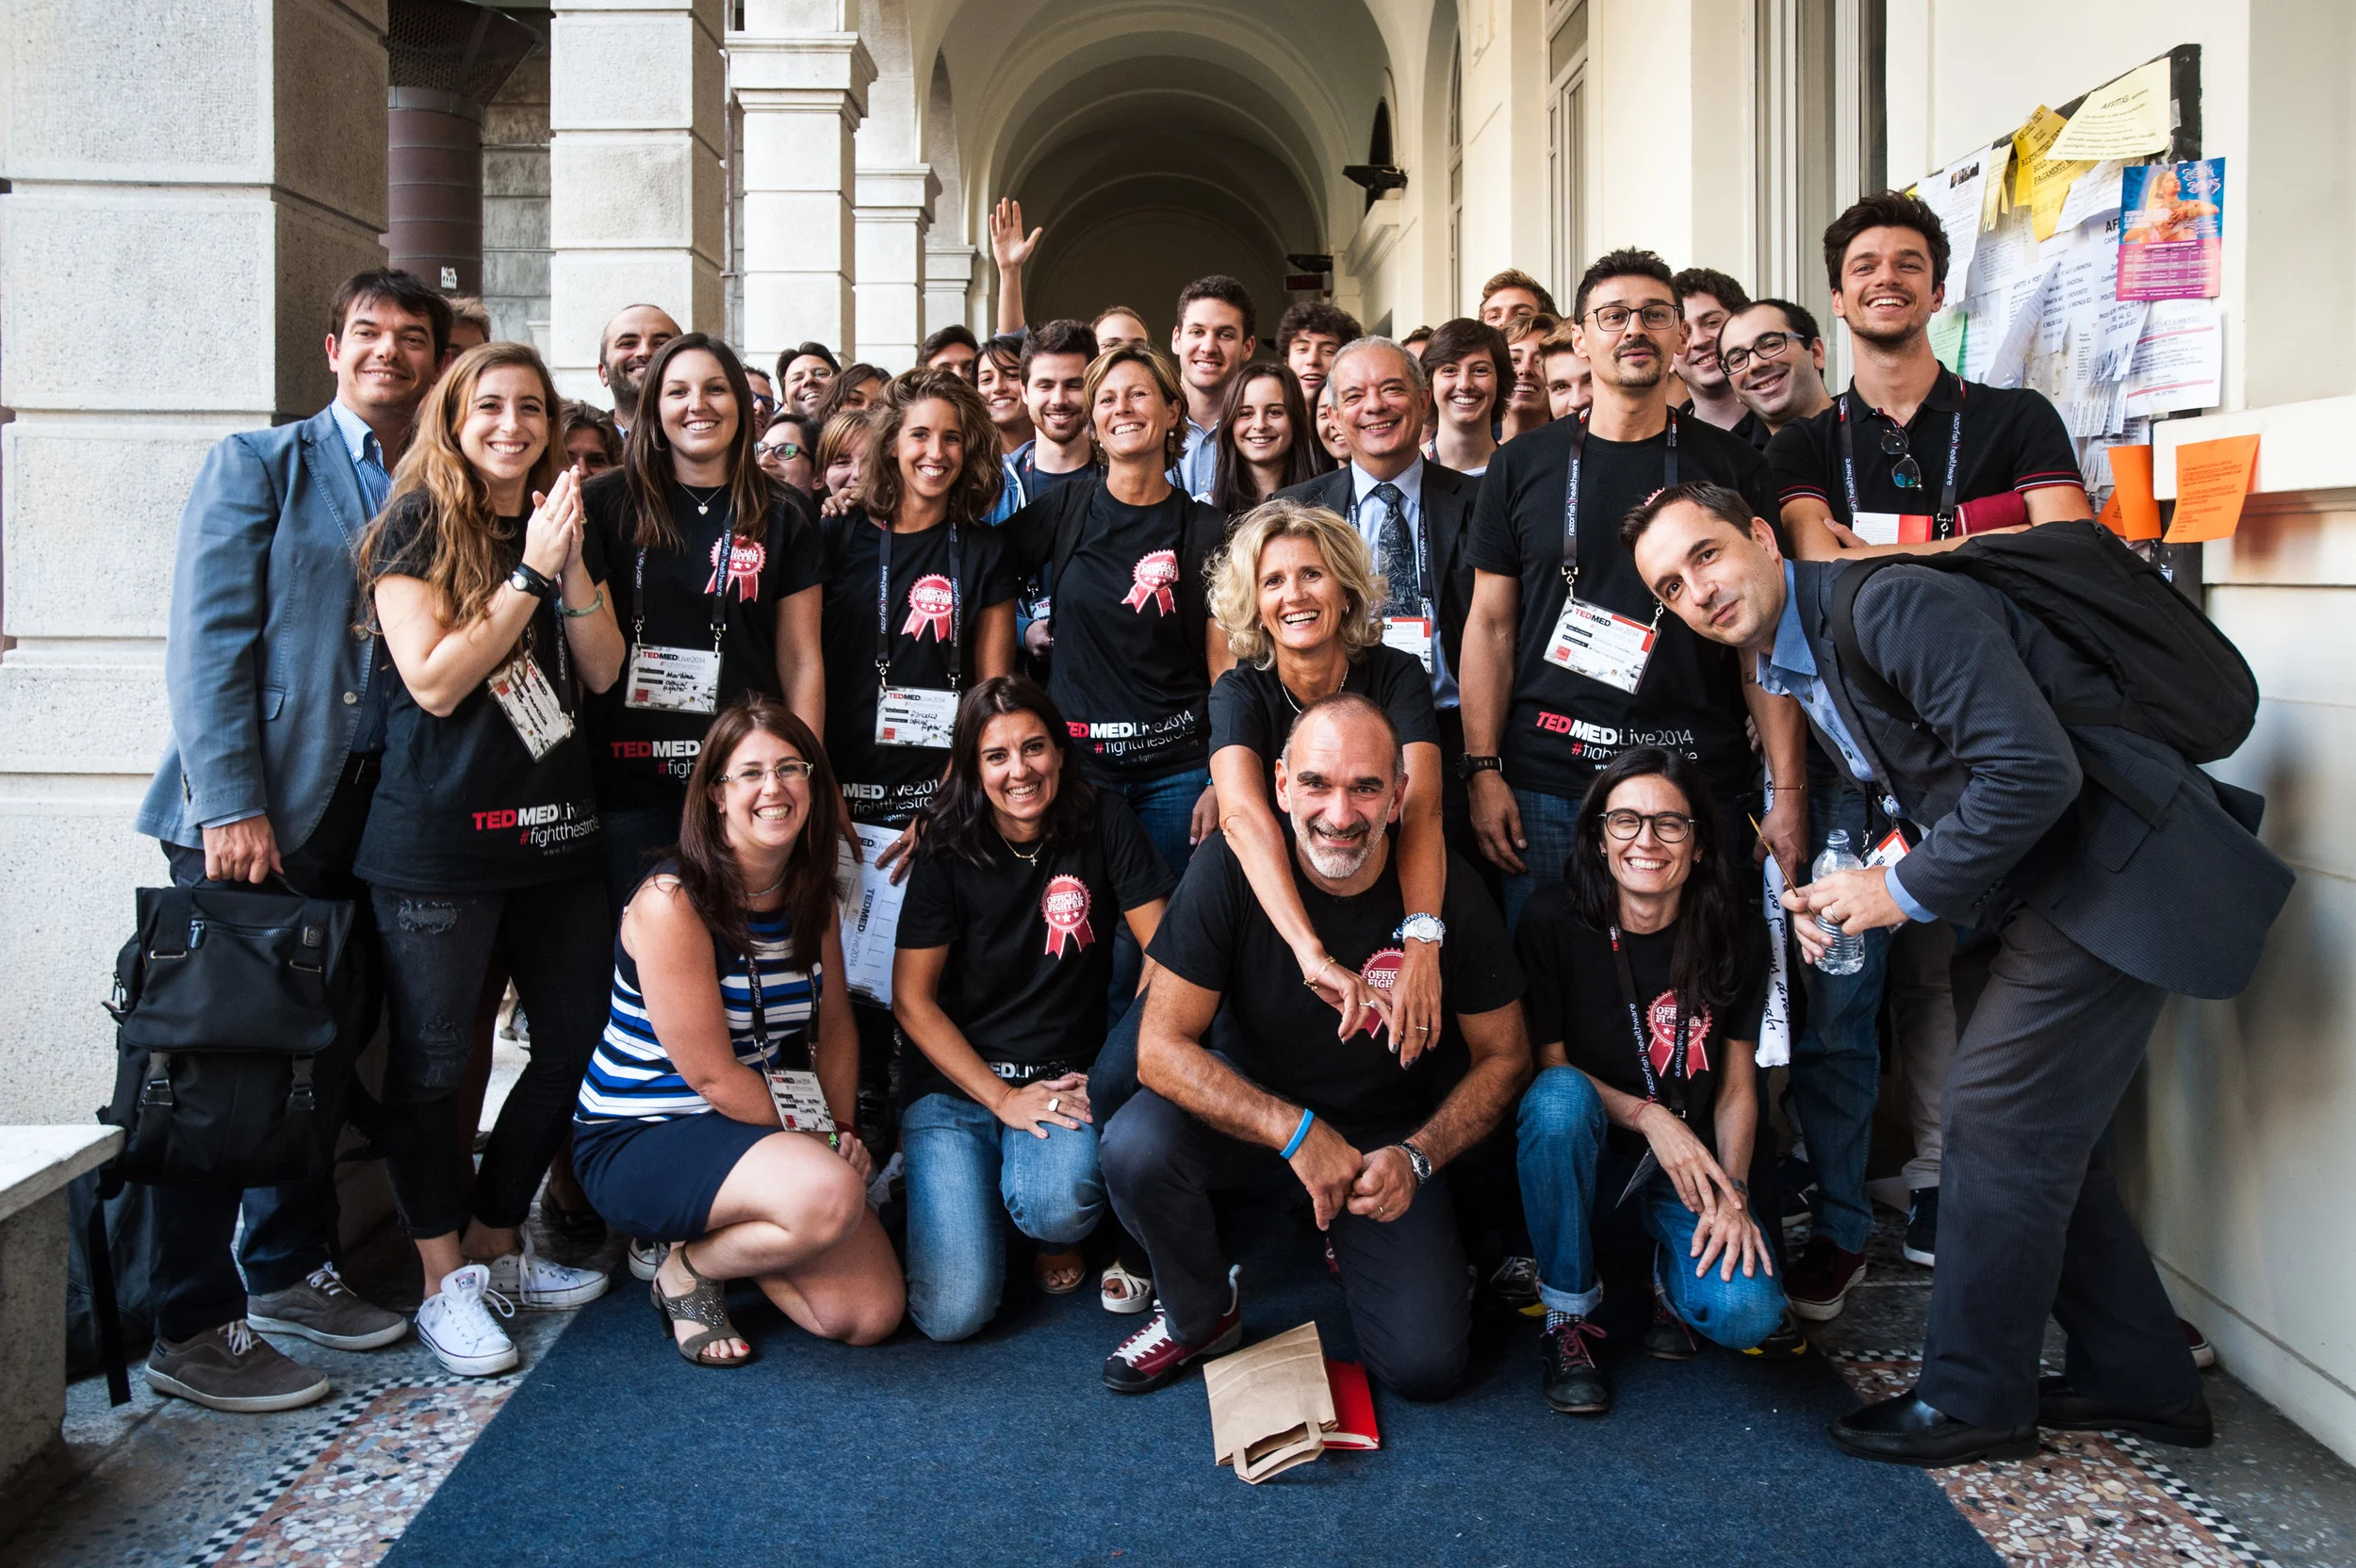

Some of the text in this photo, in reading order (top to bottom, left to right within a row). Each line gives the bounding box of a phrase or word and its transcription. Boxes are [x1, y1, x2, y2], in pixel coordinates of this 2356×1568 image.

[1946, 413, 1962, 486] razorfish healthware
[1844, 458, 1855, 498] healthware
[1568, 459, 1579, 536] razorfish healthware
[635, 557, 645, 588] razorfish
[716, 530, 730, 596] razorfish healthware
[879, 565, 888, 601] healthware
[642, 650, 706, 664] TEDMEDLive2014
[1535, 710, 1694, 745] TEDMEDLive2014
[1046, 891, 1084, 906] OFFICIAL
[1047, 899, 1085, 913] FIGHTER
[1367, 970, 1398, 980] OFFIC
[1367, 978, 1395, 989] FIGH
[1628, 1003, 1656, 1095] razorfish healthware
[1674, 1029, 1686, 1078] healthware
